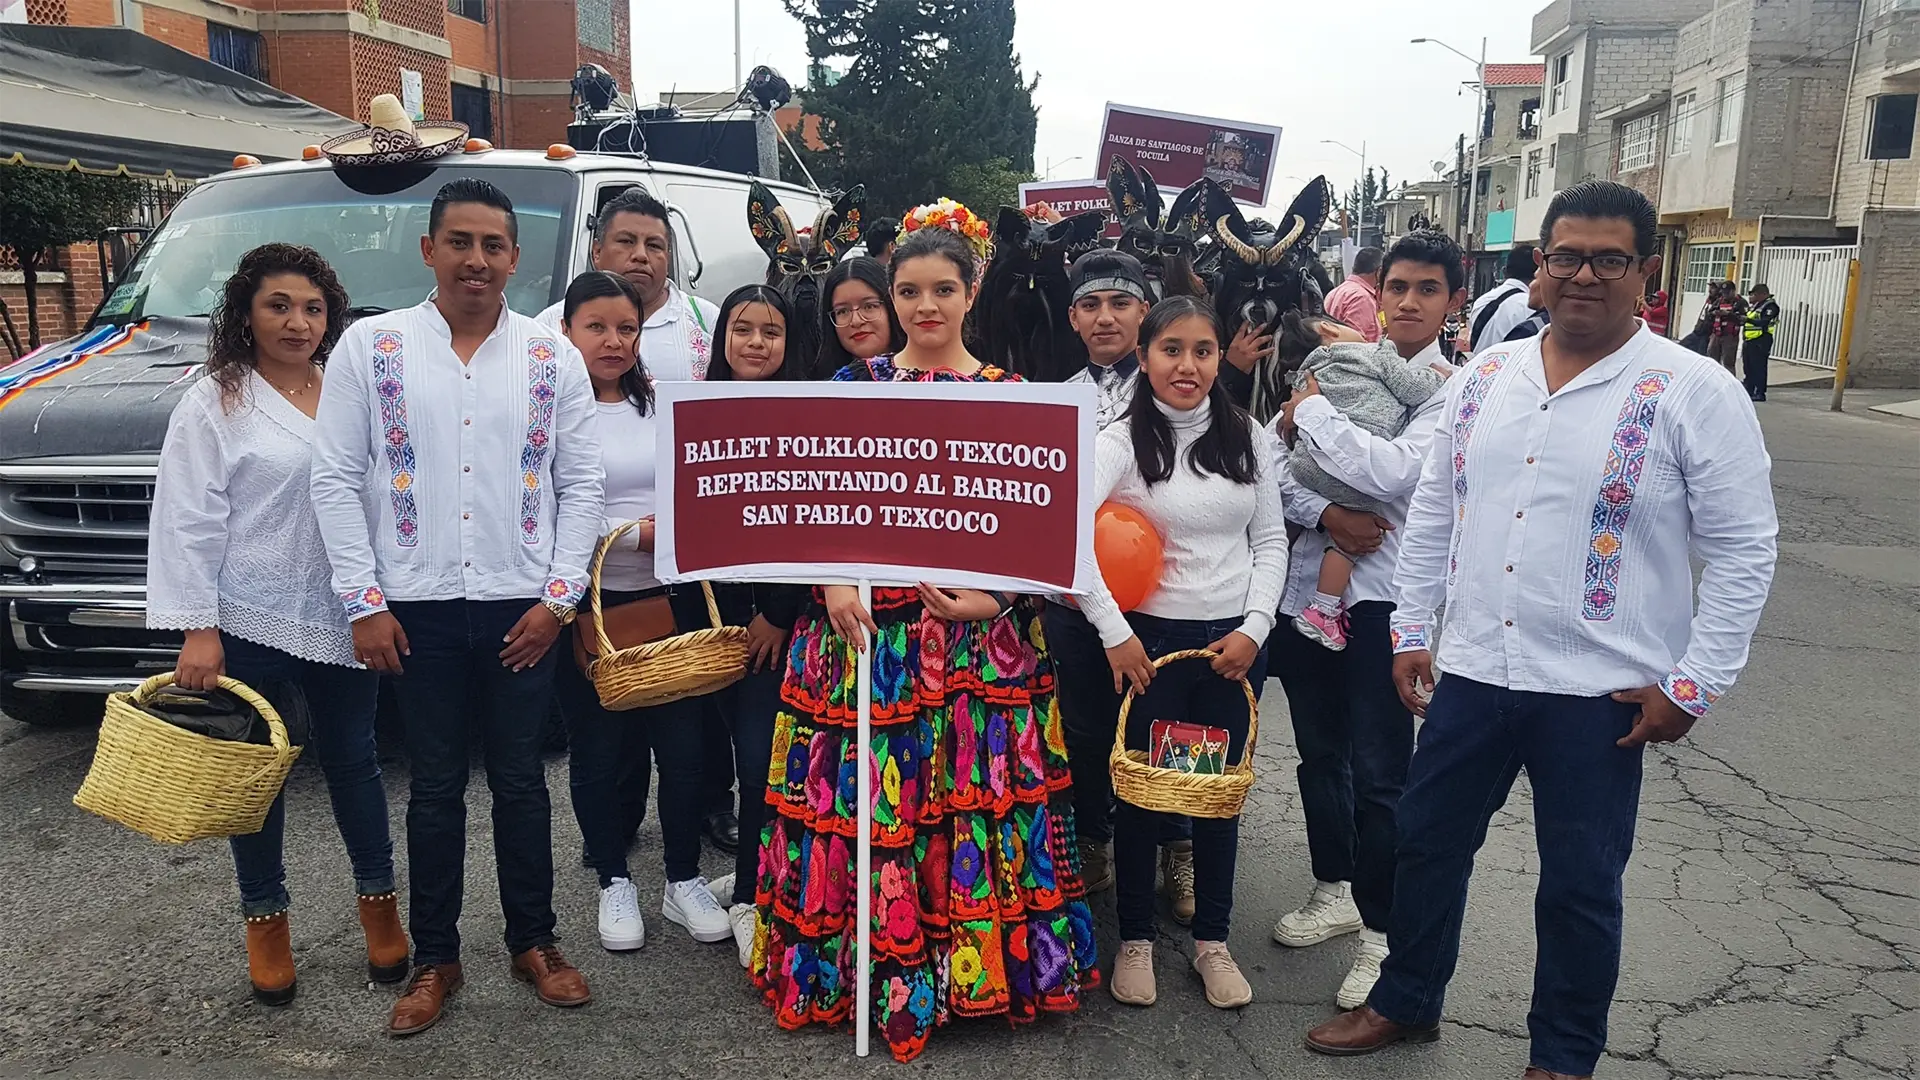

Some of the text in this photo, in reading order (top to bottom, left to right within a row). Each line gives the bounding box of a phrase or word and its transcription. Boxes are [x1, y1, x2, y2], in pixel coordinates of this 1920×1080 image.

[1108, 134, 1204, 155] DANZA DE SANTIAGOS DE
[1136, 150, 1170, 162] TOCUILA
[1050, 198, 1111, 212] LET FOLKL
[684, 436, 1067, 472] BALLET FOLKLORICO TEXCOCO
[696, 470, 1052, 507] REPRESENTANDO AL BARRIO
[742, 504, 999, 535] SAN PABLO TEXCOCO
